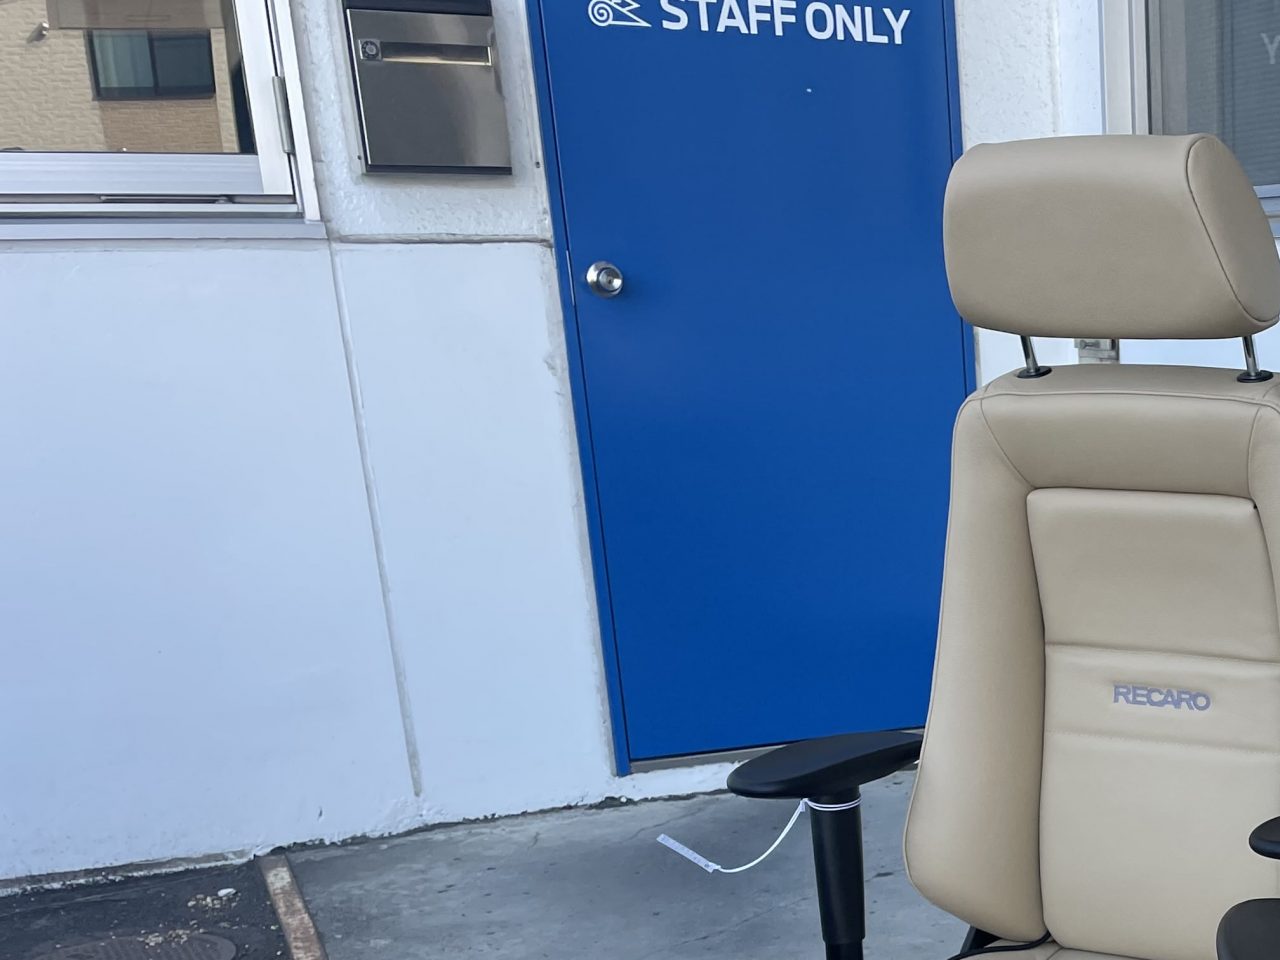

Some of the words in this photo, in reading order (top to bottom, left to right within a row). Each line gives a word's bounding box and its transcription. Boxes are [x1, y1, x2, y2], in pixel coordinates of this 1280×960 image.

[660, 0, 797, 36] STAFF
[804, 1, 911, 45] ONLY
[1112, 684, 1212, 711] RECARO
